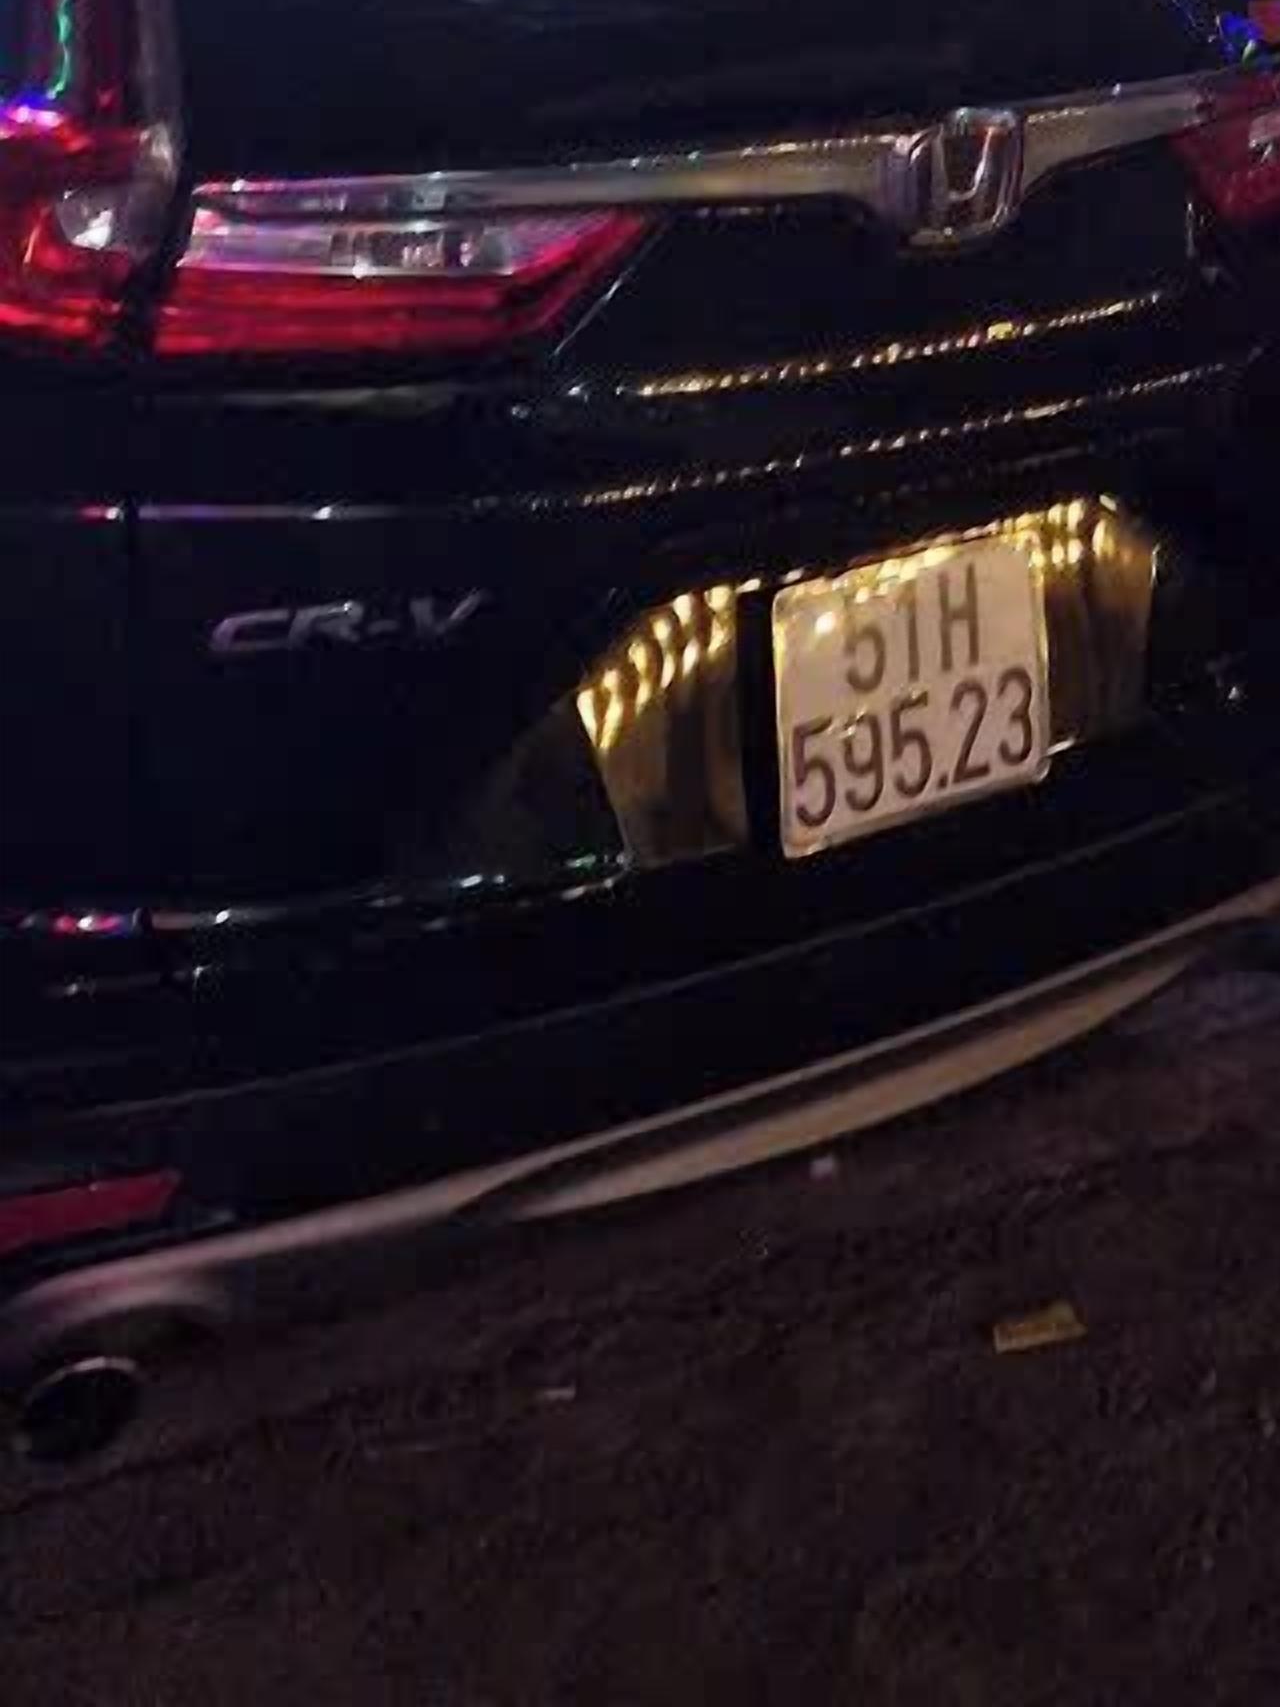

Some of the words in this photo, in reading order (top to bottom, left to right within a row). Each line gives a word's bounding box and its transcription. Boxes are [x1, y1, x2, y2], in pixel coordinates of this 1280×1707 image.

[208, 587, 486, 652] CR-V
[843, 560, 980, 694] 51H
[792, 665, 1034, 828] 595.23
